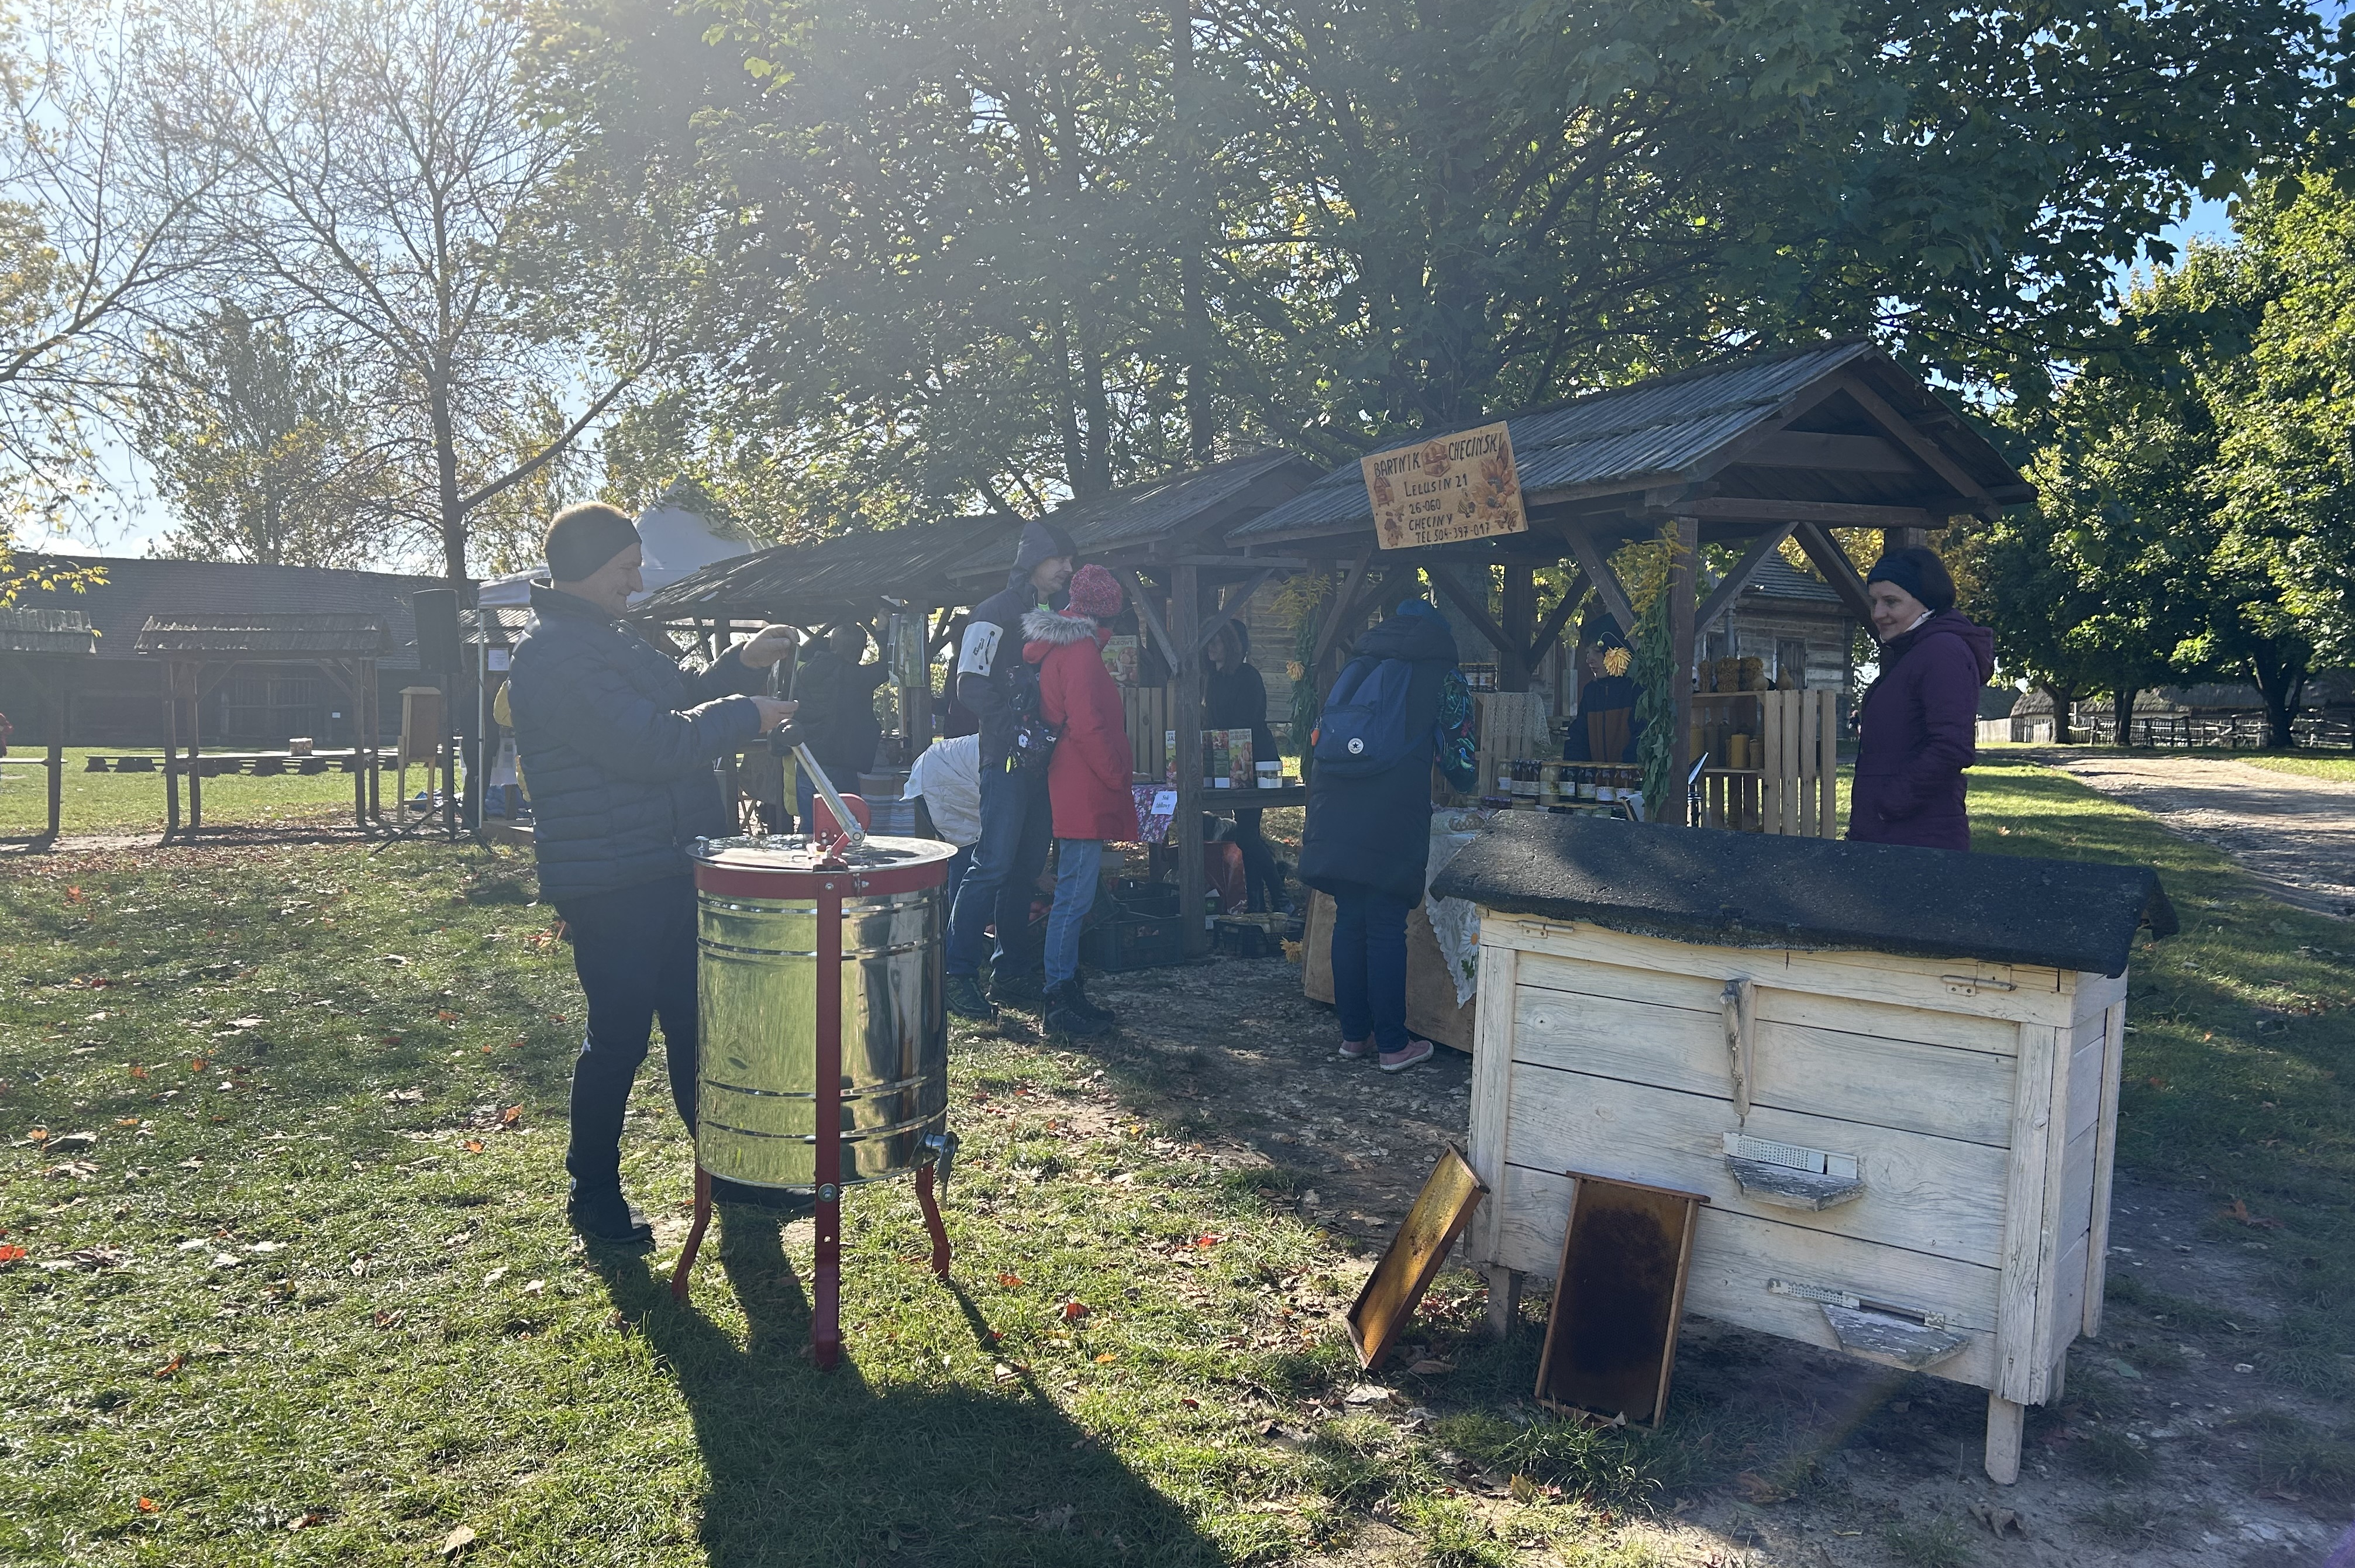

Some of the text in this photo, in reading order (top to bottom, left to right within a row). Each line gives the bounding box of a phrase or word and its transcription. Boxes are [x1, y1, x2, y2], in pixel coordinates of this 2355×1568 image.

[1373, 430, 1503, 477] BARTNIK CHĘCIŃSKI
[1455, 473, 1467, 488] 21
[1409, 498, 1441, 515] 26-060
[1416, 522, 1490, 544] TEL 504-397-017
